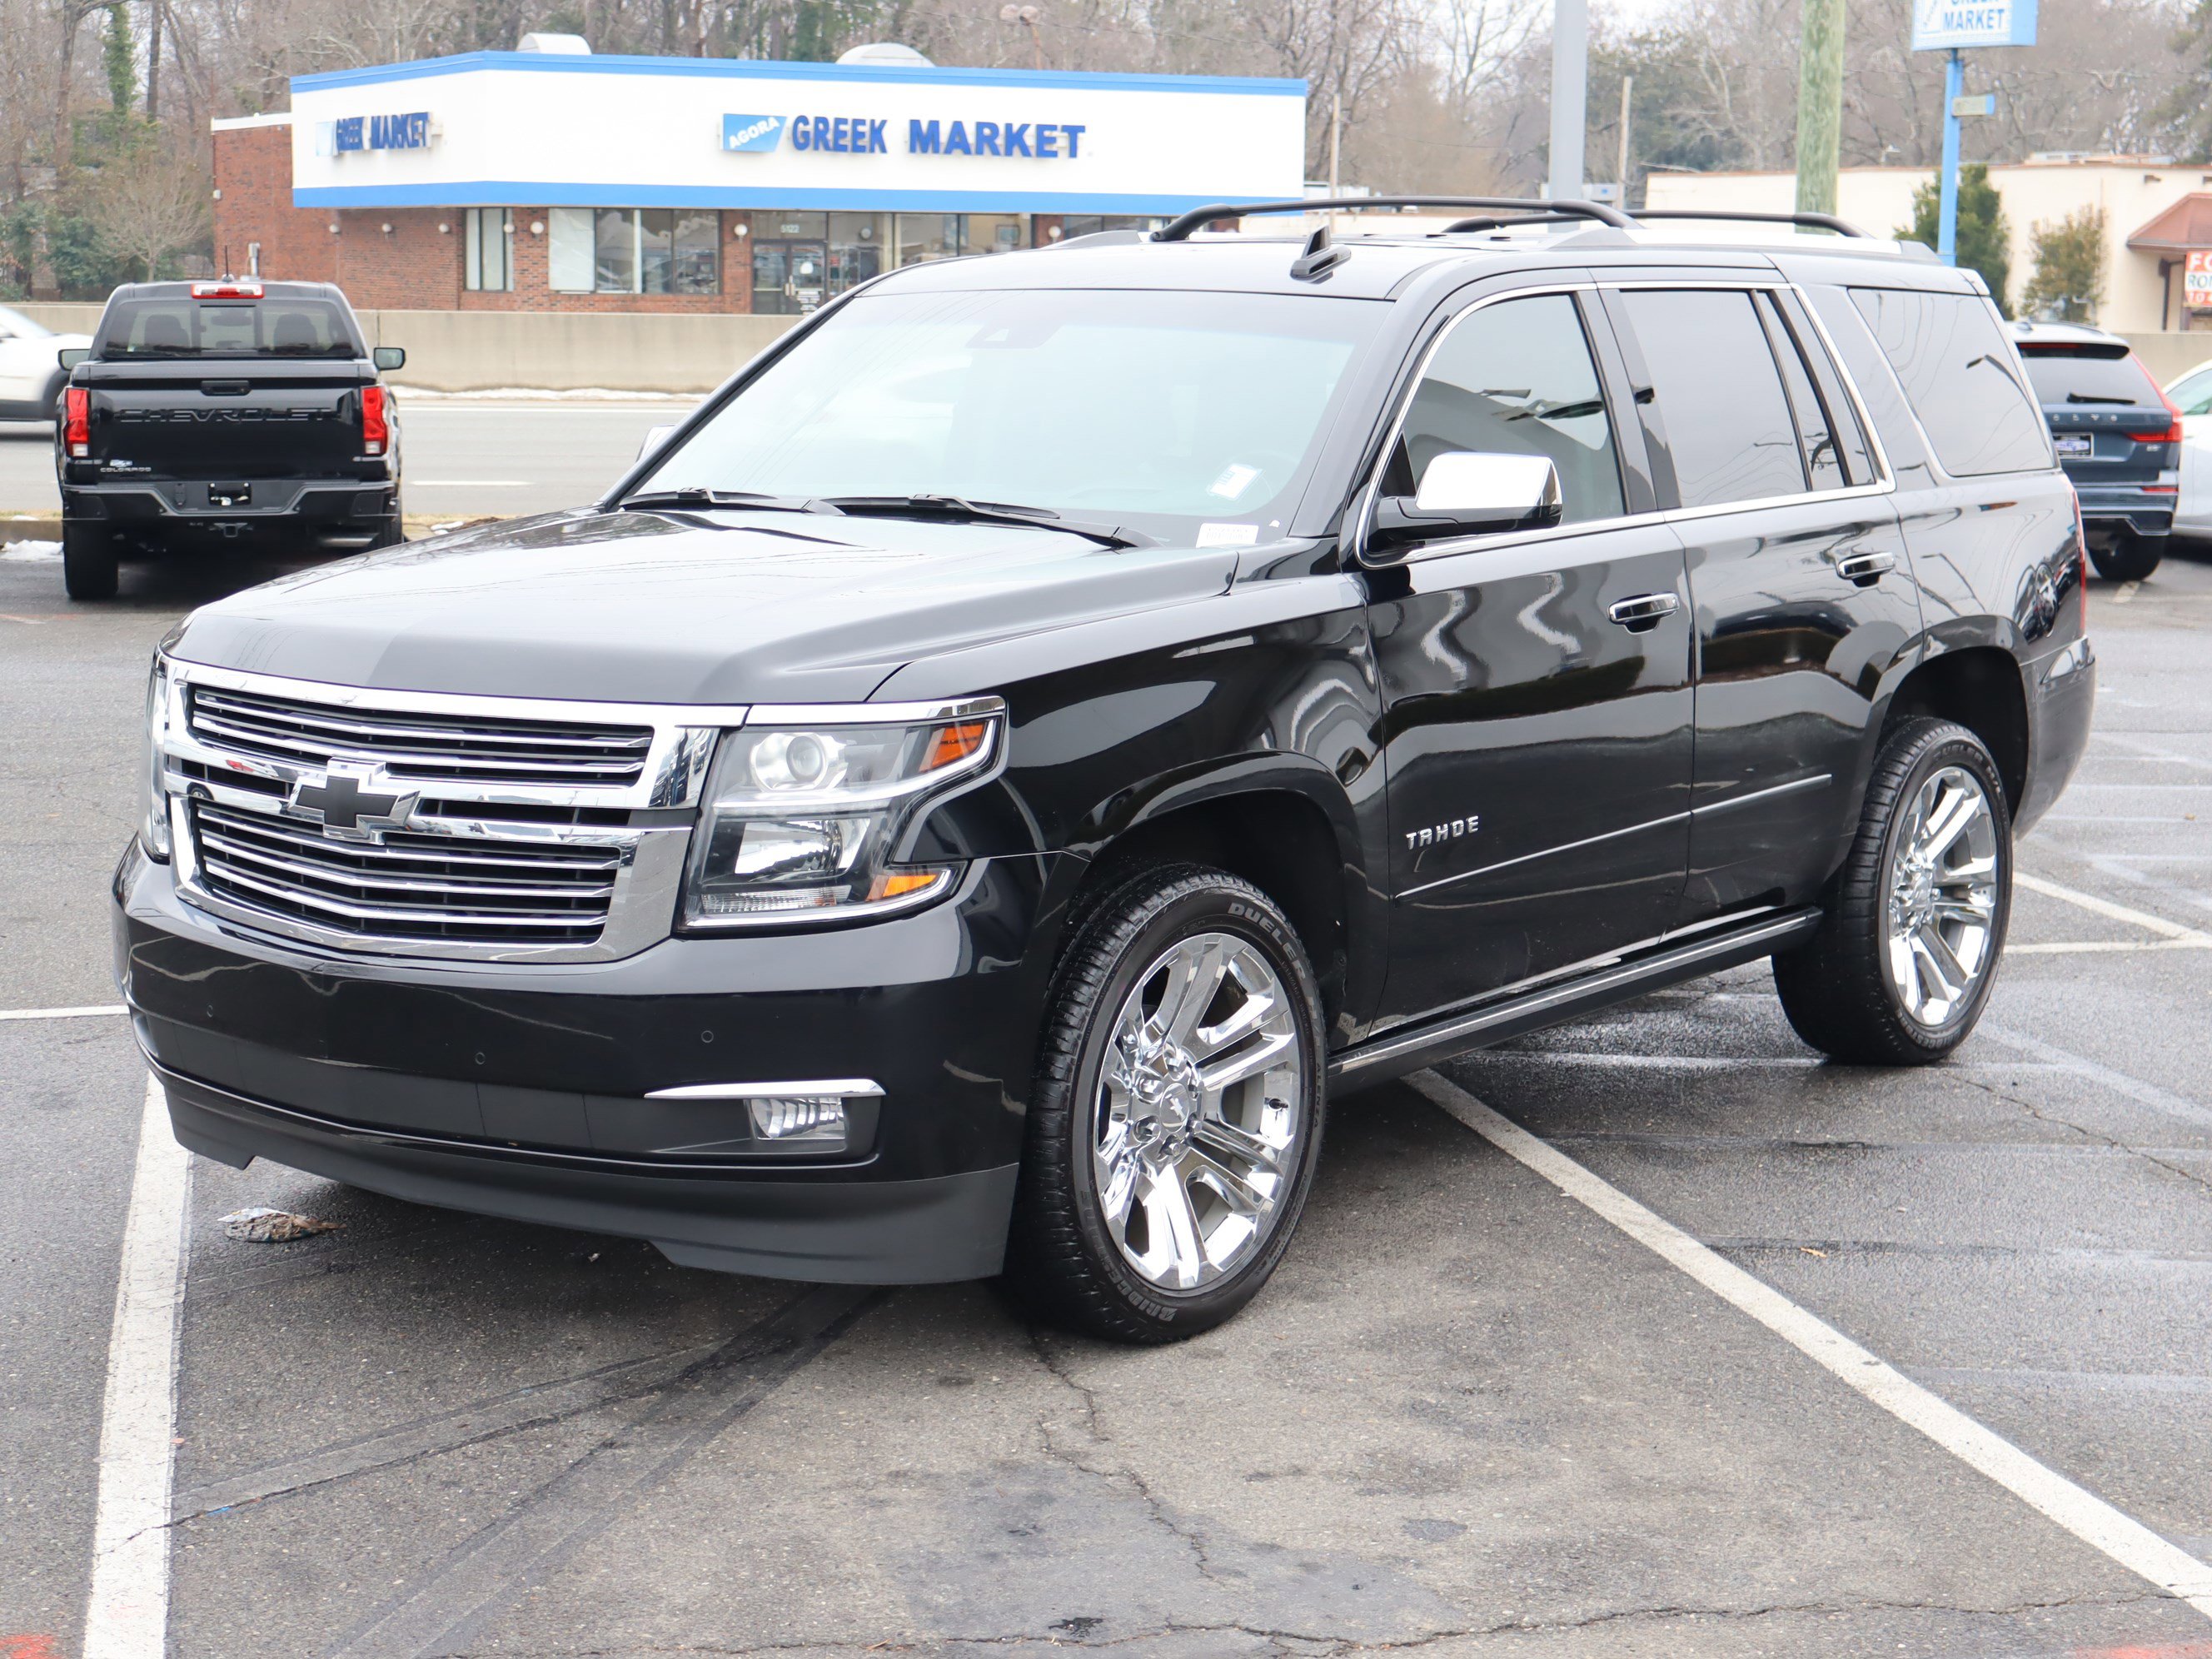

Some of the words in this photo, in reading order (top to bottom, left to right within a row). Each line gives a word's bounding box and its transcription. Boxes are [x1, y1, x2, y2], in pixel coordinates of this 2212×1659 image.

[1944, 8, 2005, 31] MARKET
[371, 111, 429, 150] MARKET
[728, 116, 780, 149] AGORA
[792, 115, 888, 154] GREEK
[909, 118, 1086, 159] MARKET
[120, 407, 331, 423] CHEVROLET
[1405, 815, 1480, 850] TAHOE
[1227, 901, 1307, 980] DUELER
